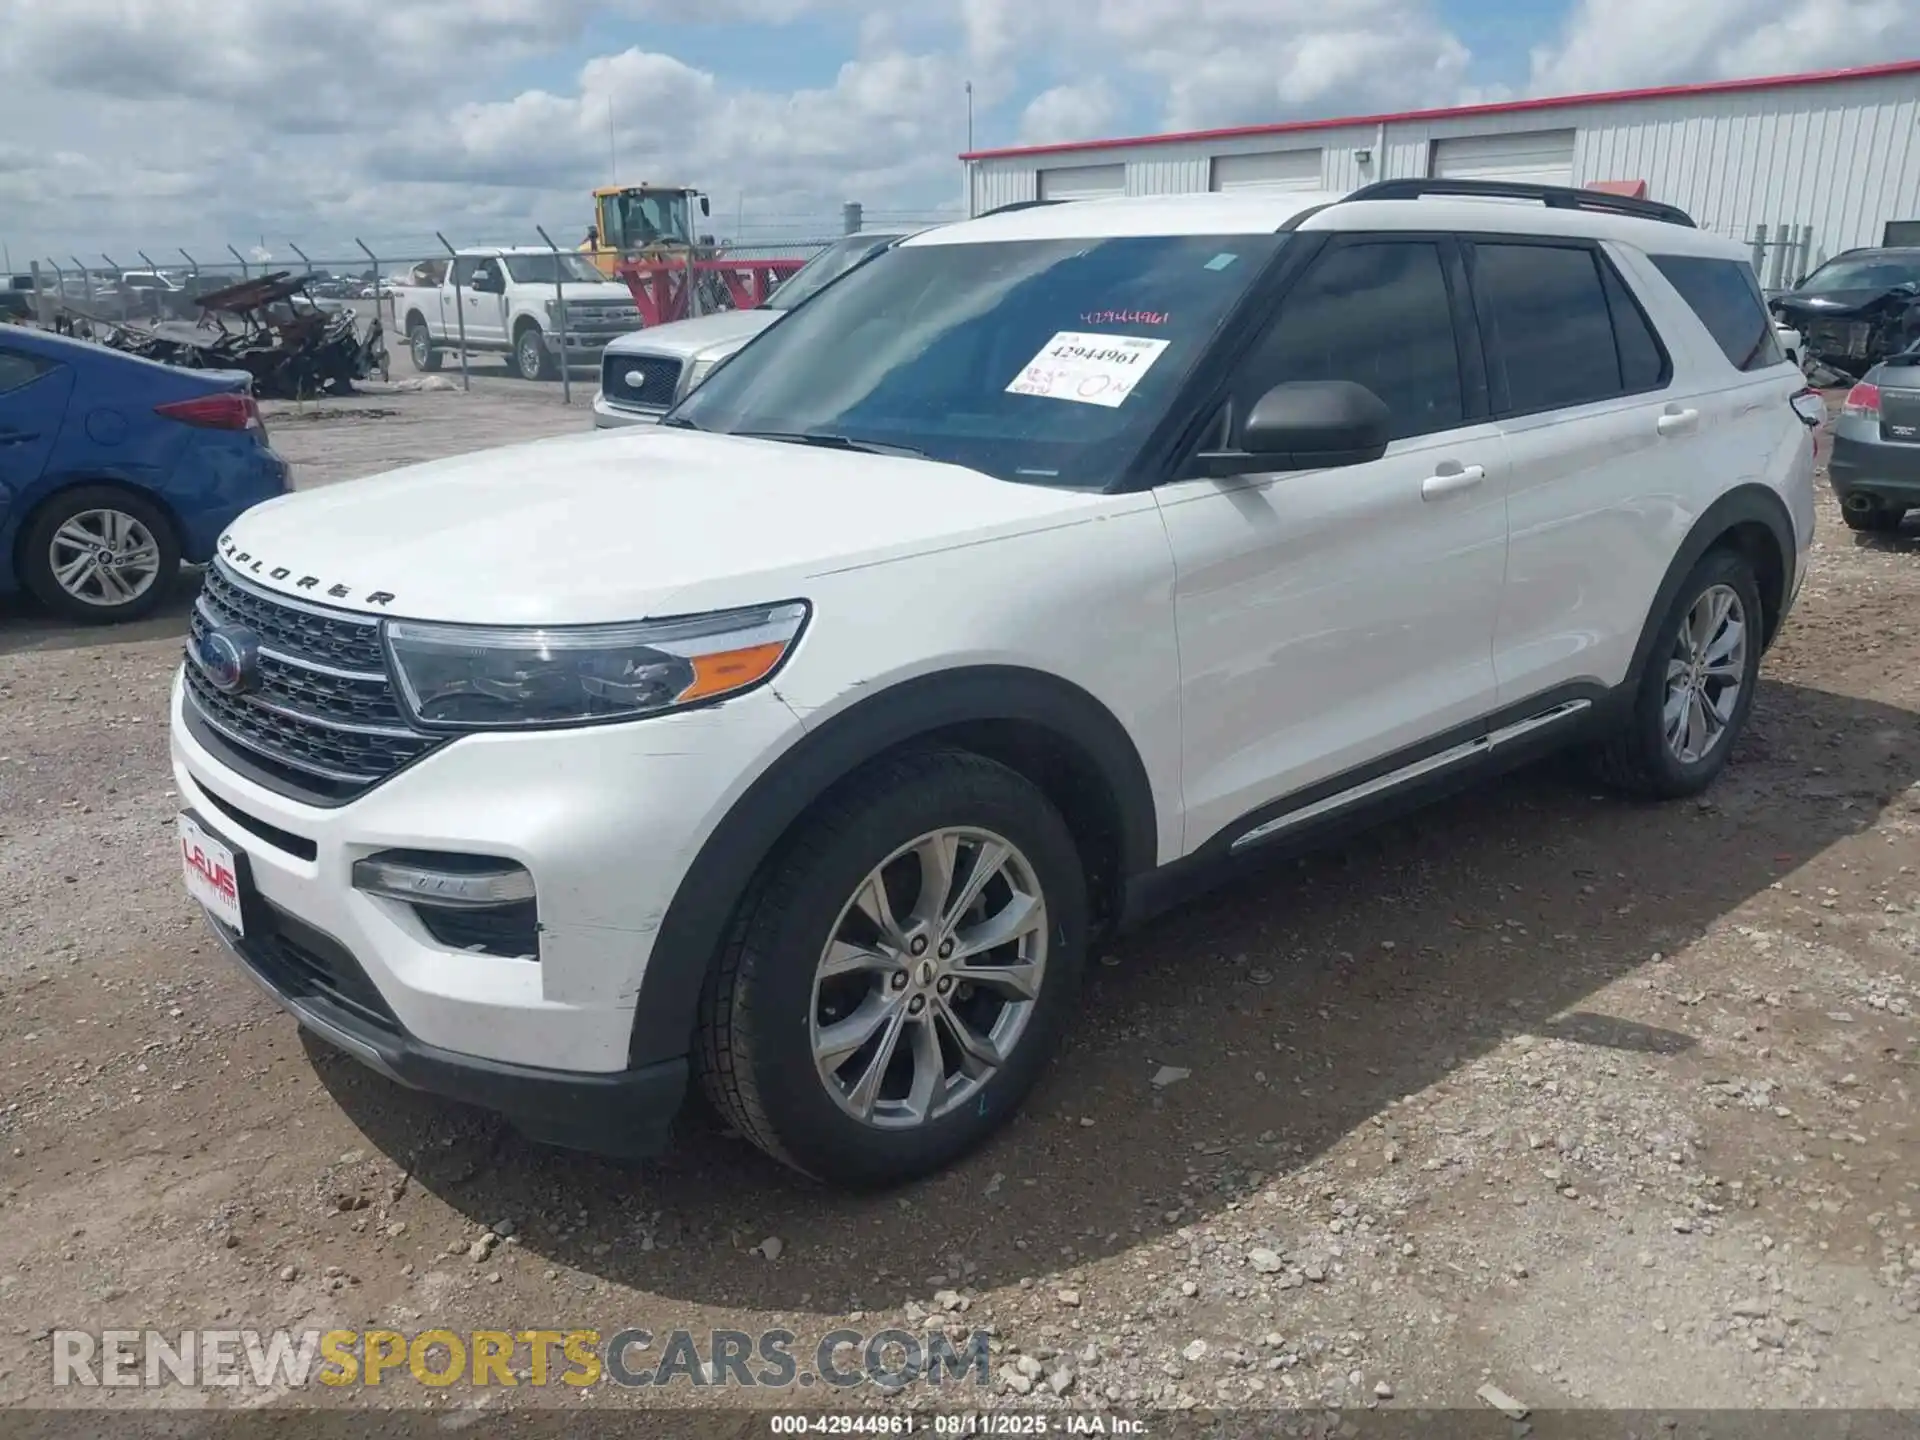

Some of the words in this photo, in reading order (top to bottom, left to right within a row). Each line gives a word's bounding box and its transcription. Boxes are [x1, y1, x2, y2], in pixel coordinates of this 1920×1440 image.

[1080, 309, 1169, 324] 42944961
[1051, 346, 1140, 365] 42944961
[220, 534, 396, 607] EXPLORER
